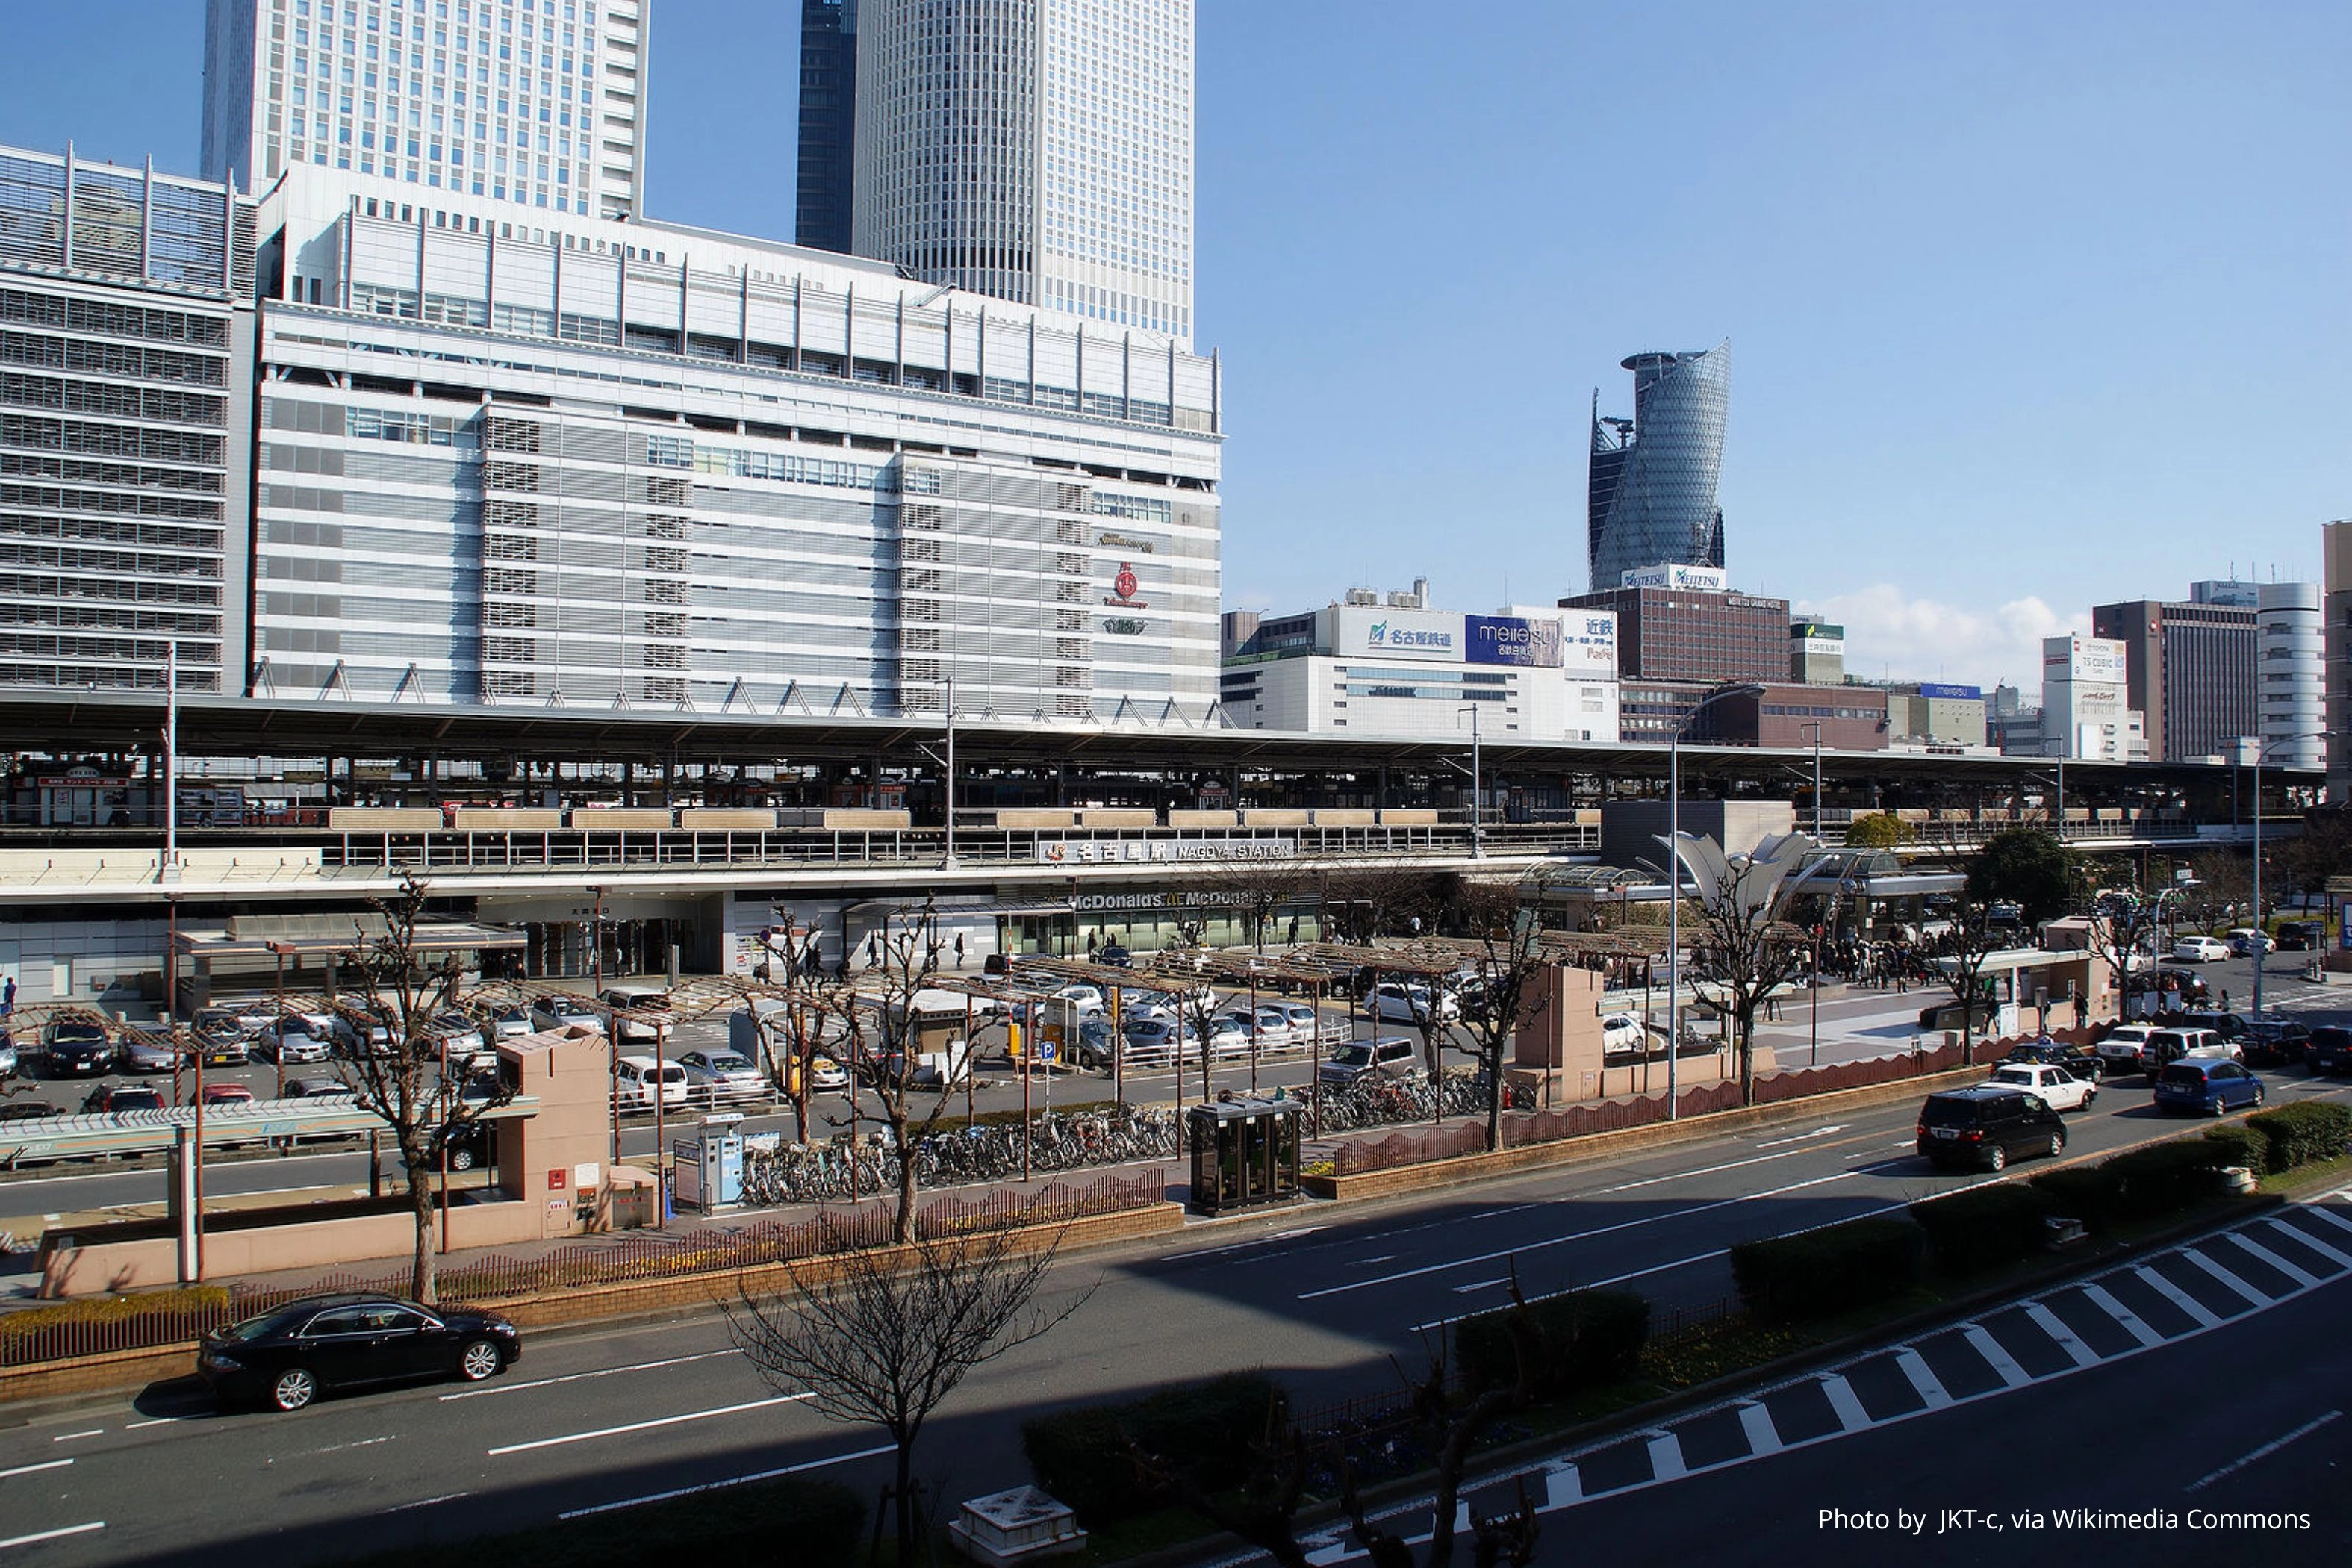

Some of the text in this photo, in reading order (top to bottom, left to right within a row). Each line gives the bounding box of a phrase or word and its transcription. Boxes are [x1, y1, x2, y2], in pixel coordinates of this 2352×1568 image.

[1390, 629, 1452, 647] 名古屋鉄道
[1045, 842, 1289, 861] JR 名古屋駅 NAGOYA STATION
[1069, 893, 1162, 910] McDonald's
